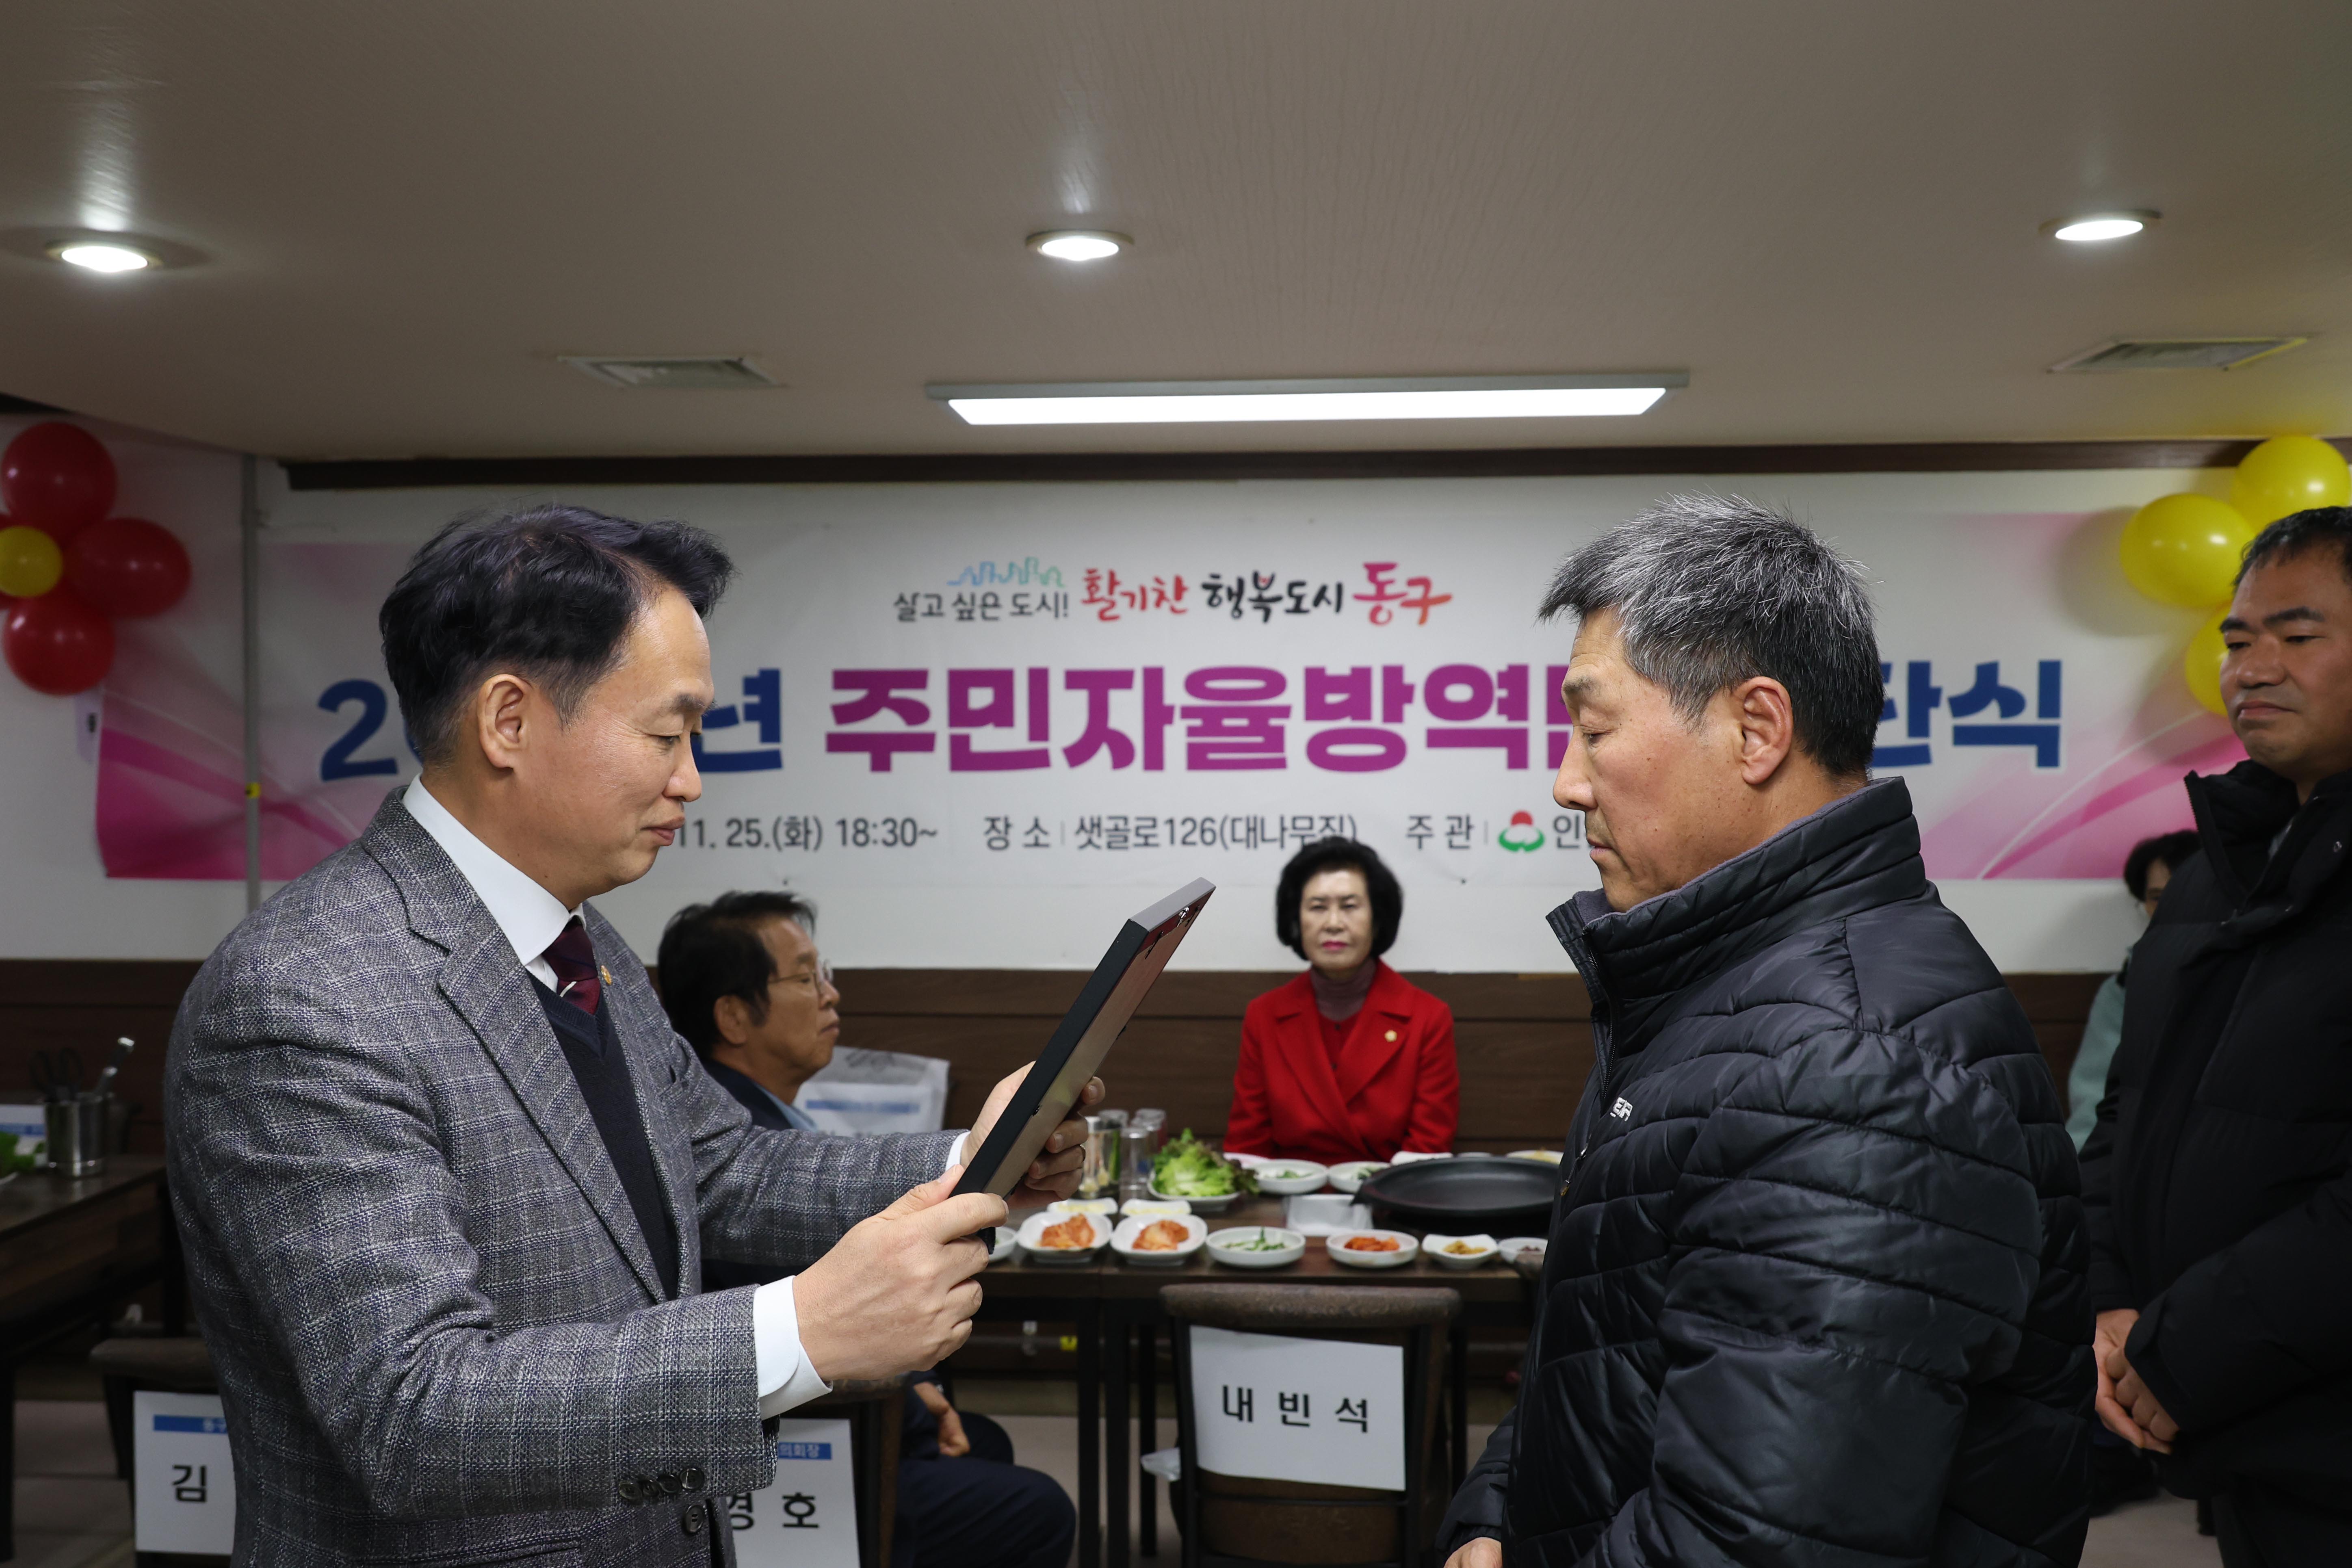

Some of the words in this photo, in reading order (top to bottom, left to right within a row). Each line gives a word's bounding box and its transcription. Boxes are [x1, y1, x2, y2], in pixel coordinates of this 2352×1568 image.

[893, 591, 944, 623] 살고
[951, 591, 1002, 622] 싶은
[1009, 591, 1069, 619] 도시!
[1081, 567, 1189, 622] 활기찬
[1200, 570, 1344, 624] 행복도시
[1351, 561, 1453, 626] 동구
[825, 663, 1573, 773] 주민자율방역
[835, 817, 938, 848] 18:30~
[1553, 814, 1592, 849] 인
[172, 1464, 207, 1503] 김
[782, 1492, 819, 1529] 호
